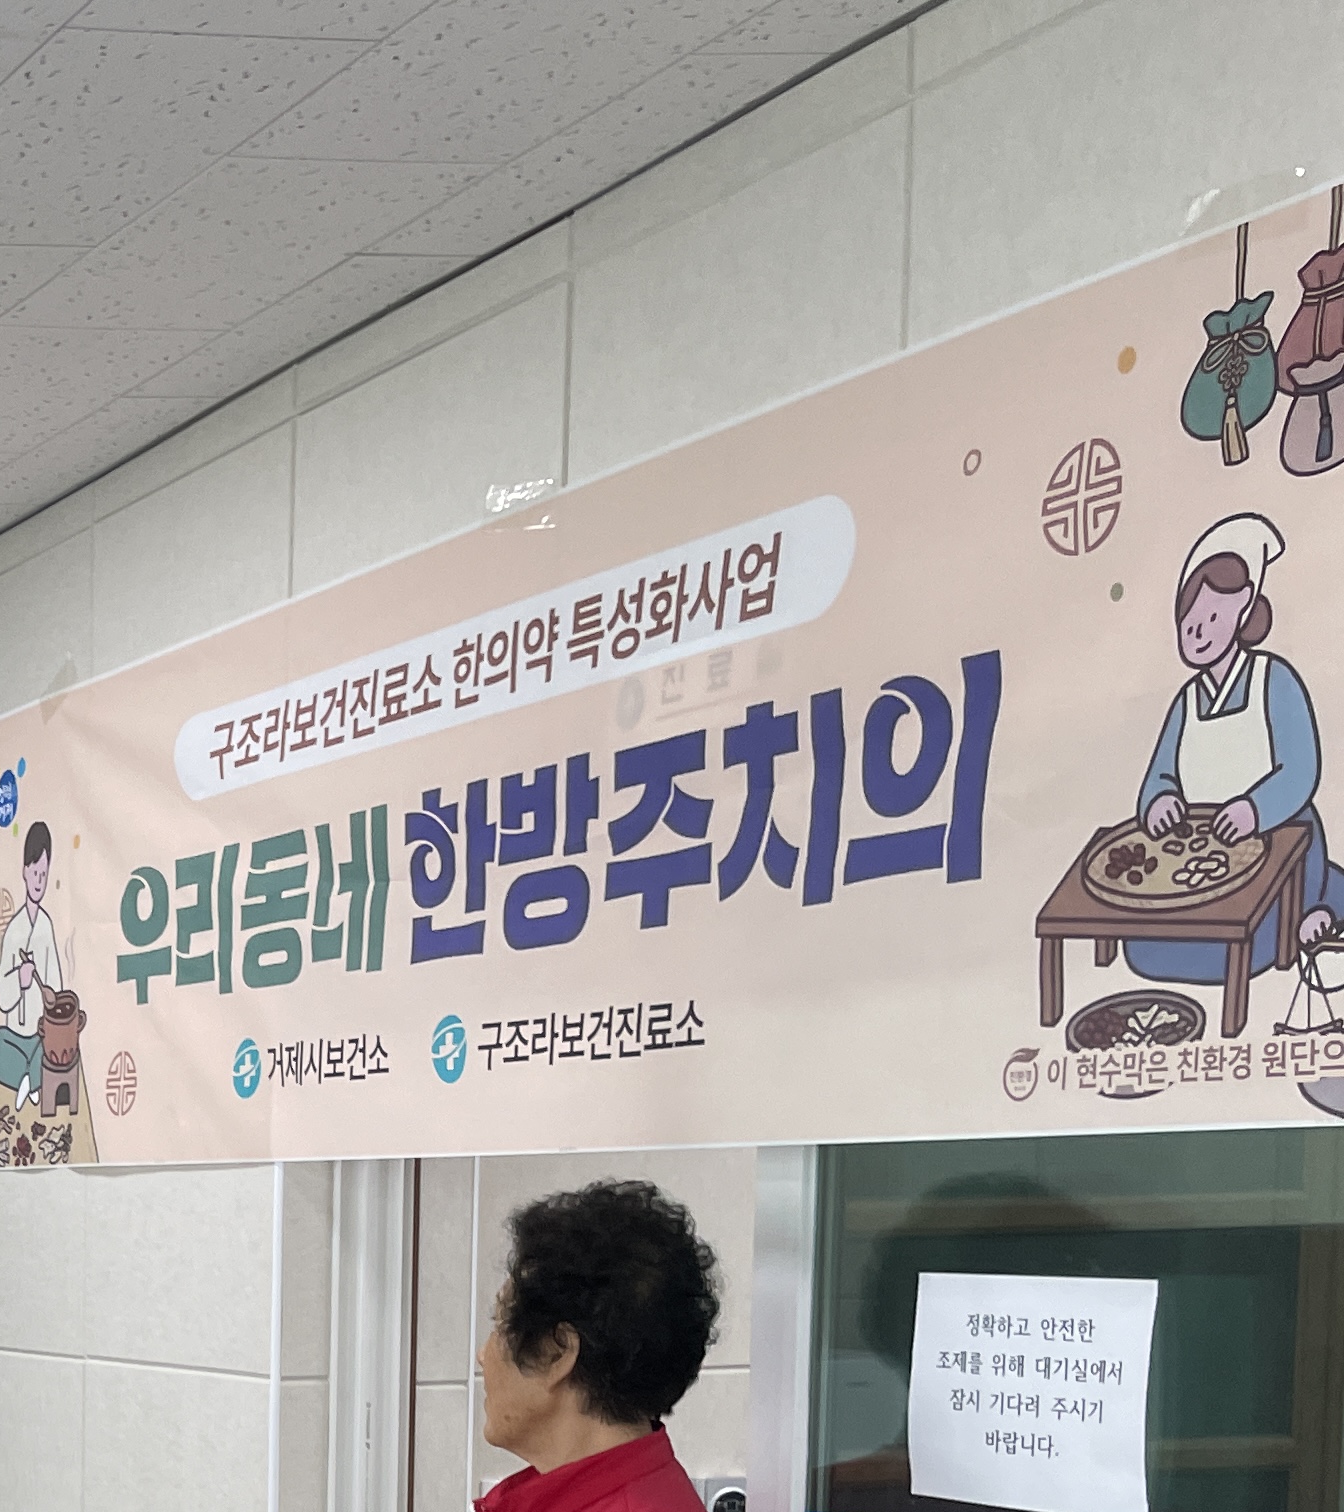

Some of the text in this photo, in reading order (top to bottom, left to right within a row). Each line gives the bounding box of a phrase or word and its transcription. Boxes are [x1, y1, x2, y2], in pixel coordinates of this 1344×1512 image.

[210, 531, 782, 779] 구조라보건진료소 한의약 특성화사업
[116, 650, 1002, 1004] 우리동네 한방주치의
[477, 1000, 705, 1070] 구조라보건진료소
[267, 1033, 389, 1087] 거제시보건소
[1047, 1056, 1068, 1090] 이
[1077, 1051, 1169, 1089] 현수막은
[1177, 1043, 1252, 1082] 친환경
[966, 1313, 1095, 1343] 정확하고 안전한
[936, 1351, 1123, 1386] 조제를 위해 대기실에서
[949, 1388, 1103, 1424] 잠시 기다려 주시기
[985, 1430, 1060, 1459] 바랍니다.
